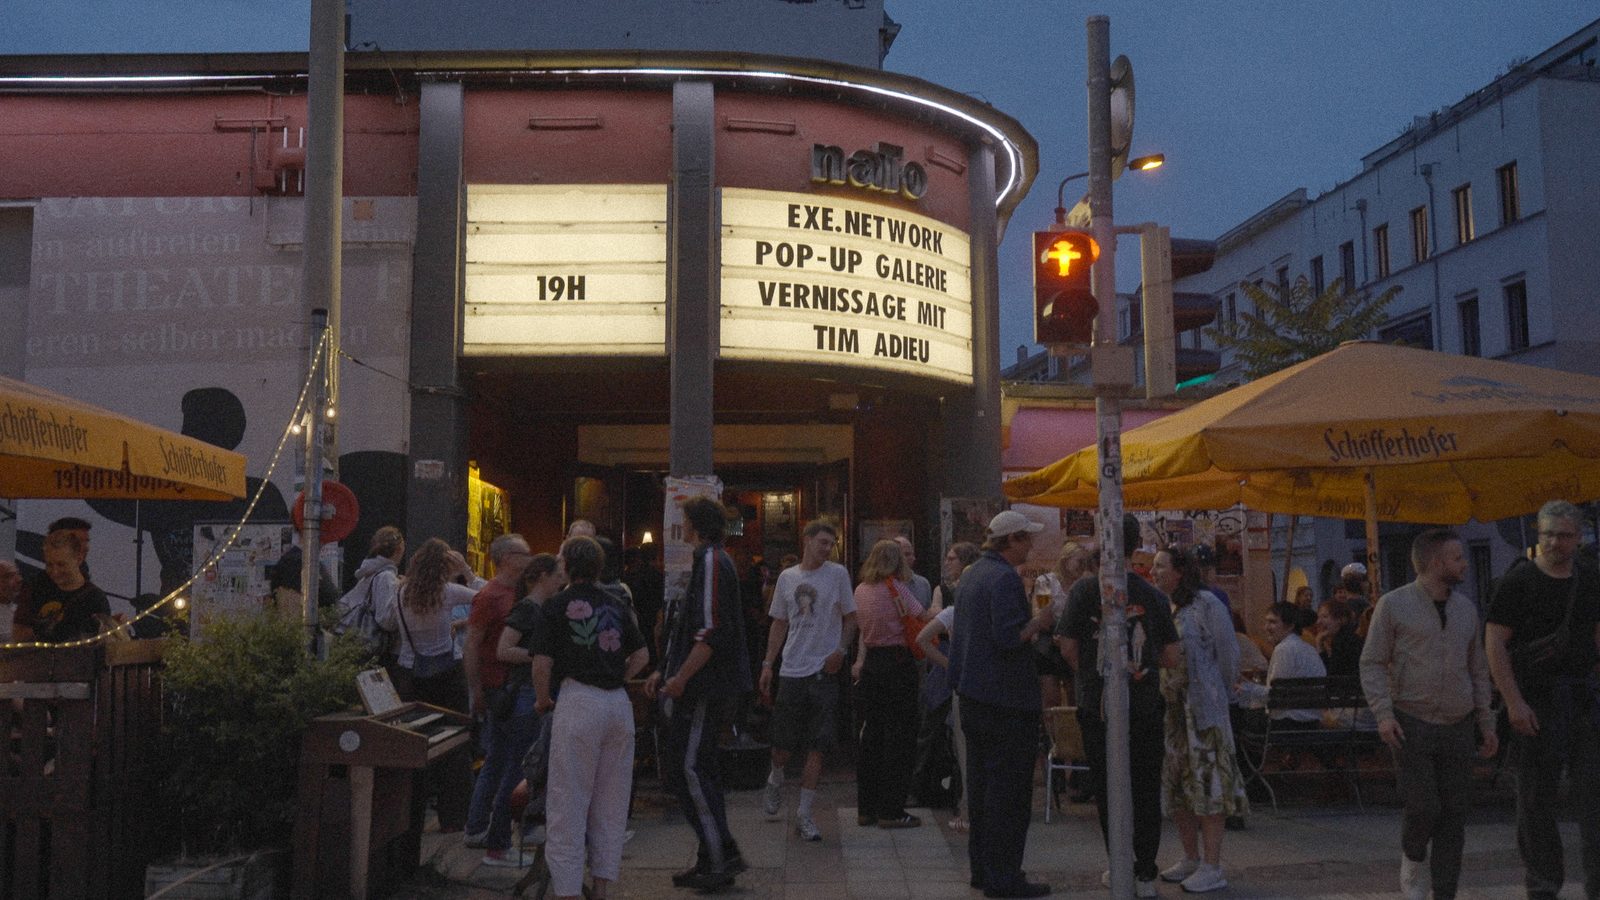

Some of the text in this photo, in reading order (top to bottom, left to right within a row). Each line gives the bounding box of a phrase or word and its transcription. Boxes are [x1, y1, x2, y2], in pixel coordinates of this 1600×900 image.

[811, 141, 928, 200] nato
[85, 227, 242, 258] auftreten
[788, 203, 943, 255] EXE.NETWORK
[536, 275, 586, 301] 19H
[755, 240, 948, 293] POP-UP GALERIE
[40, 264, 296, 316] THEATE
[758, 281, 947, 330] VERNISSAGE MIT
[122, 321, 227, 354] selber
[813, 324, 930, 364] TIM ADIEU
[1324, 426, 1458, 463] Schöfferhofer
